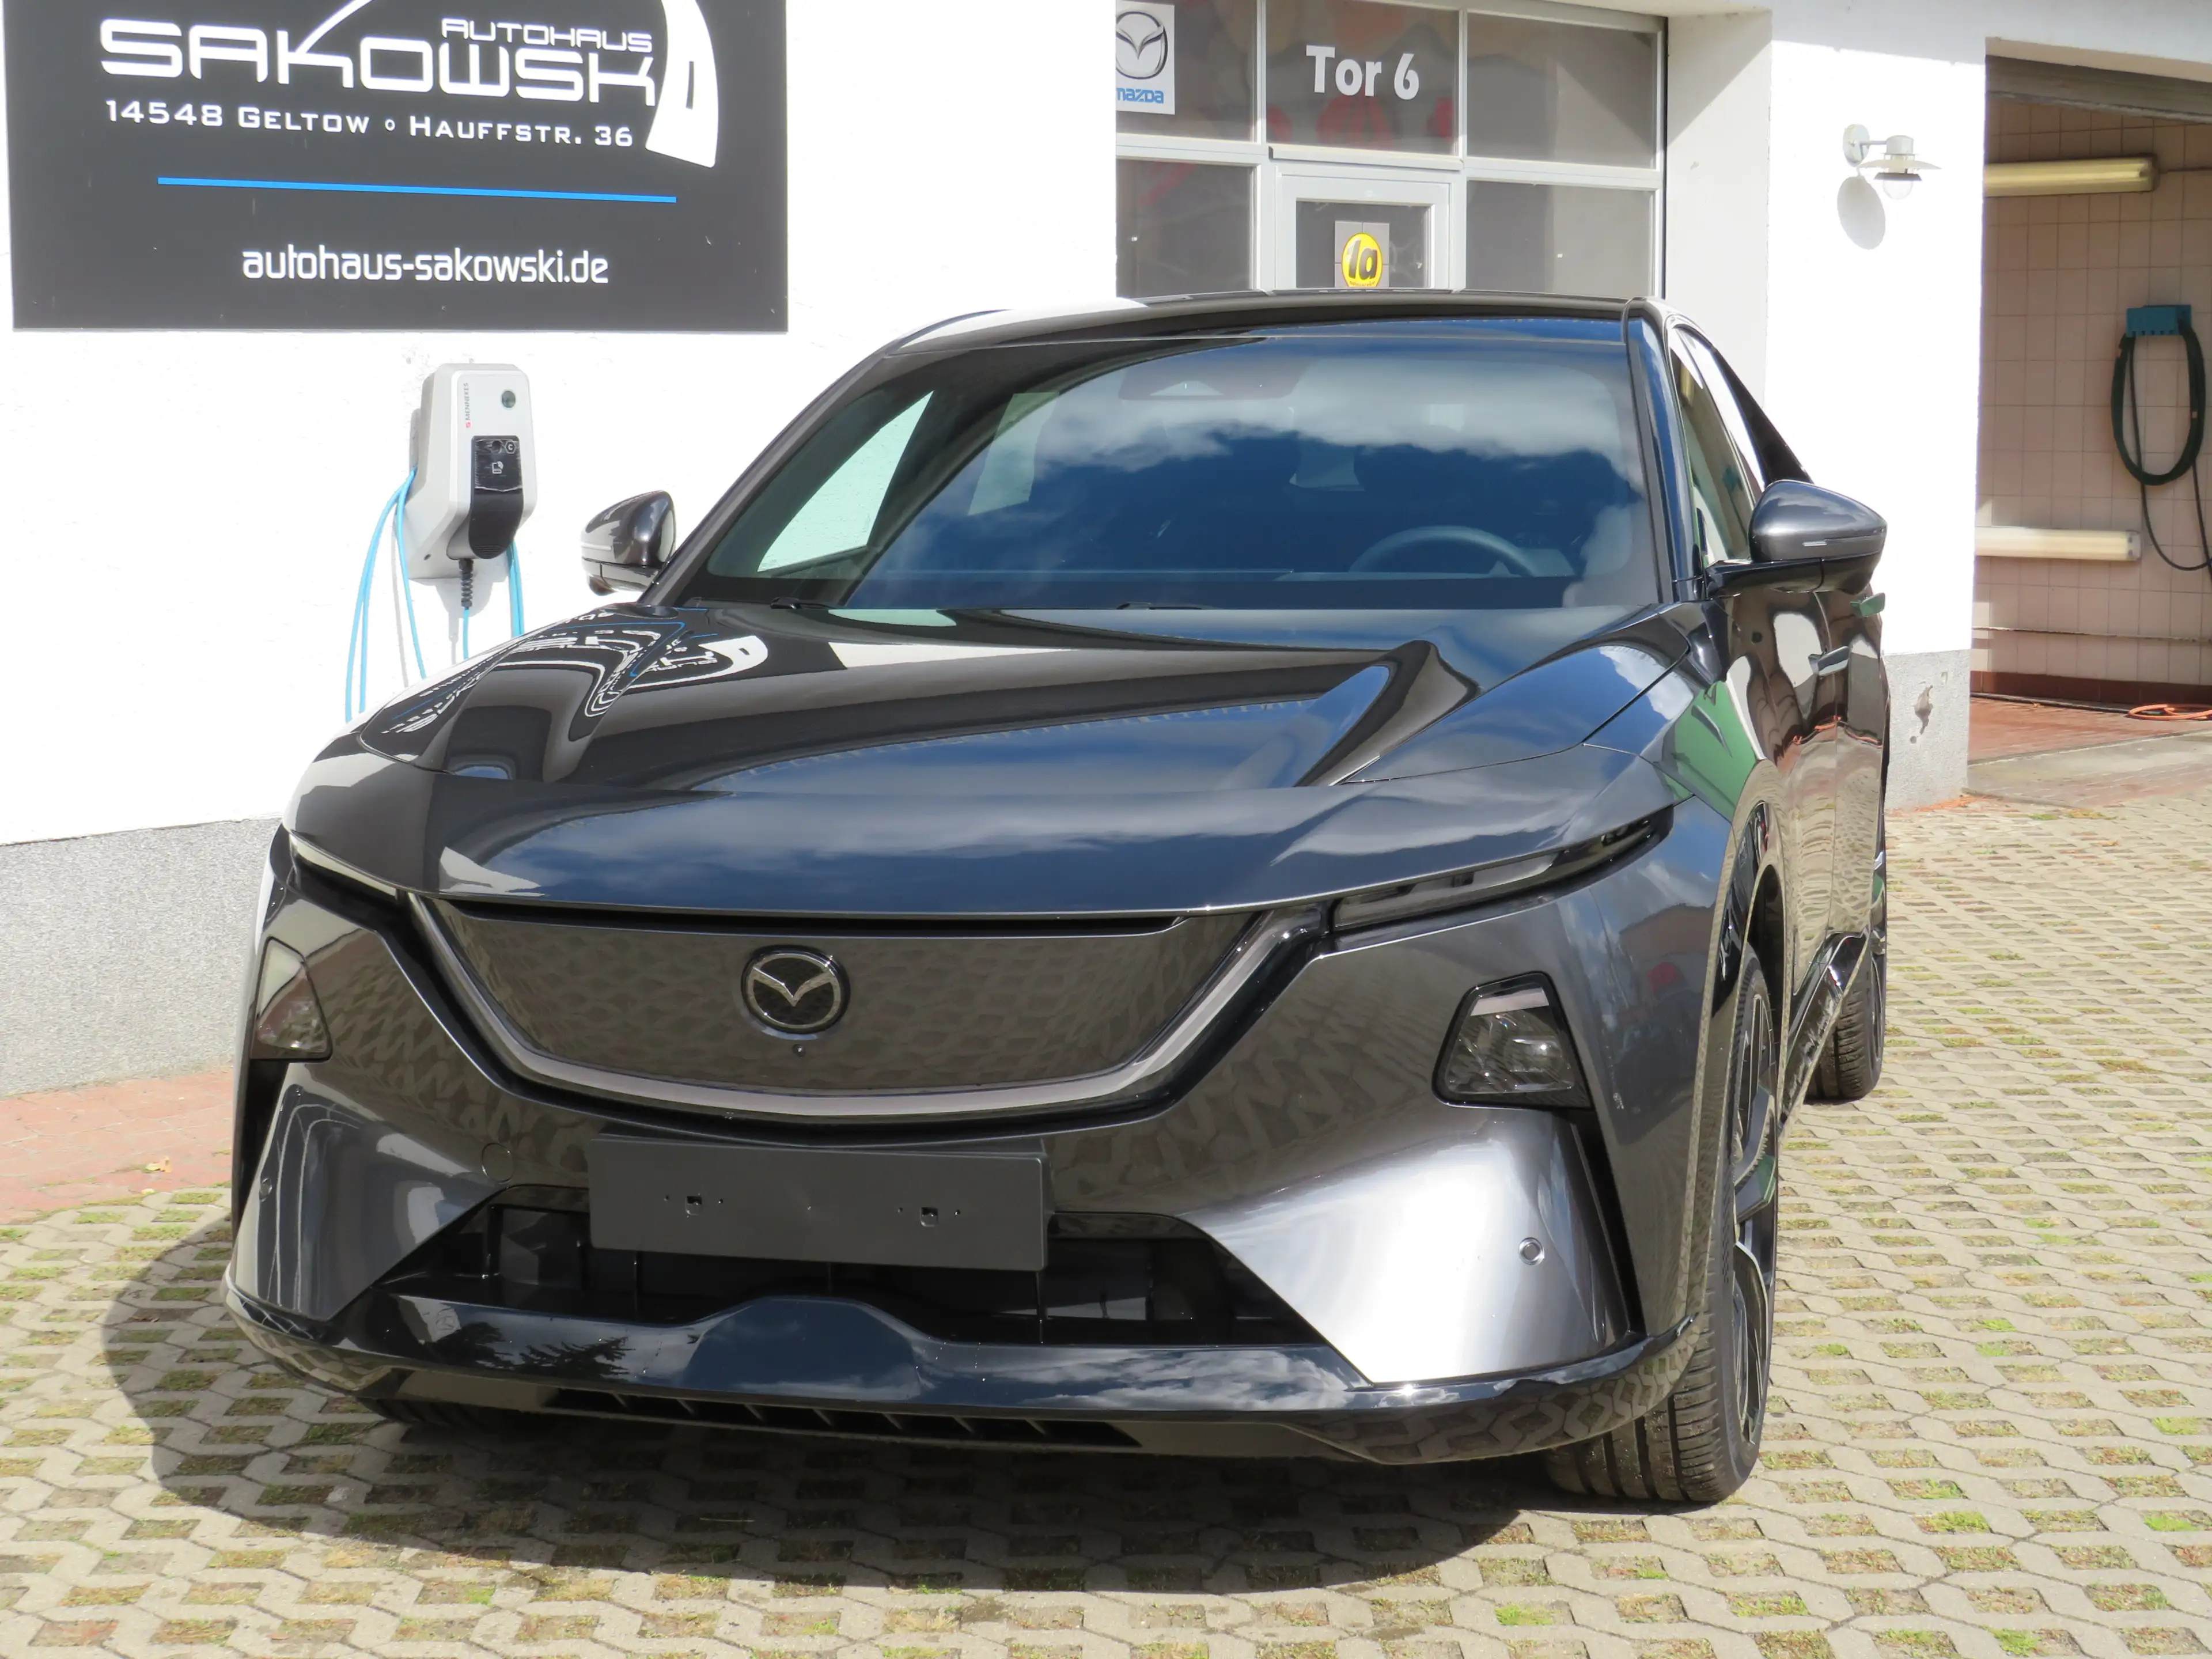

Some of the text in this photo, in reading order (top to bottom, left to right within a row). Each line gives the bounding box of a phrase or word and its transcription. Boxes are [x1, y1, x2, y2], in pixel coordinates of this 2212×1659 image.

[441, 18, 653, 53] AUTOHAUS
[1306, 46, 1419, 100] Tor 6
[106, 100, 223, 127] 14548
[594, 125, 632, 147] 36
[243, 244, 609, 283] autohaus-sakowski.de
